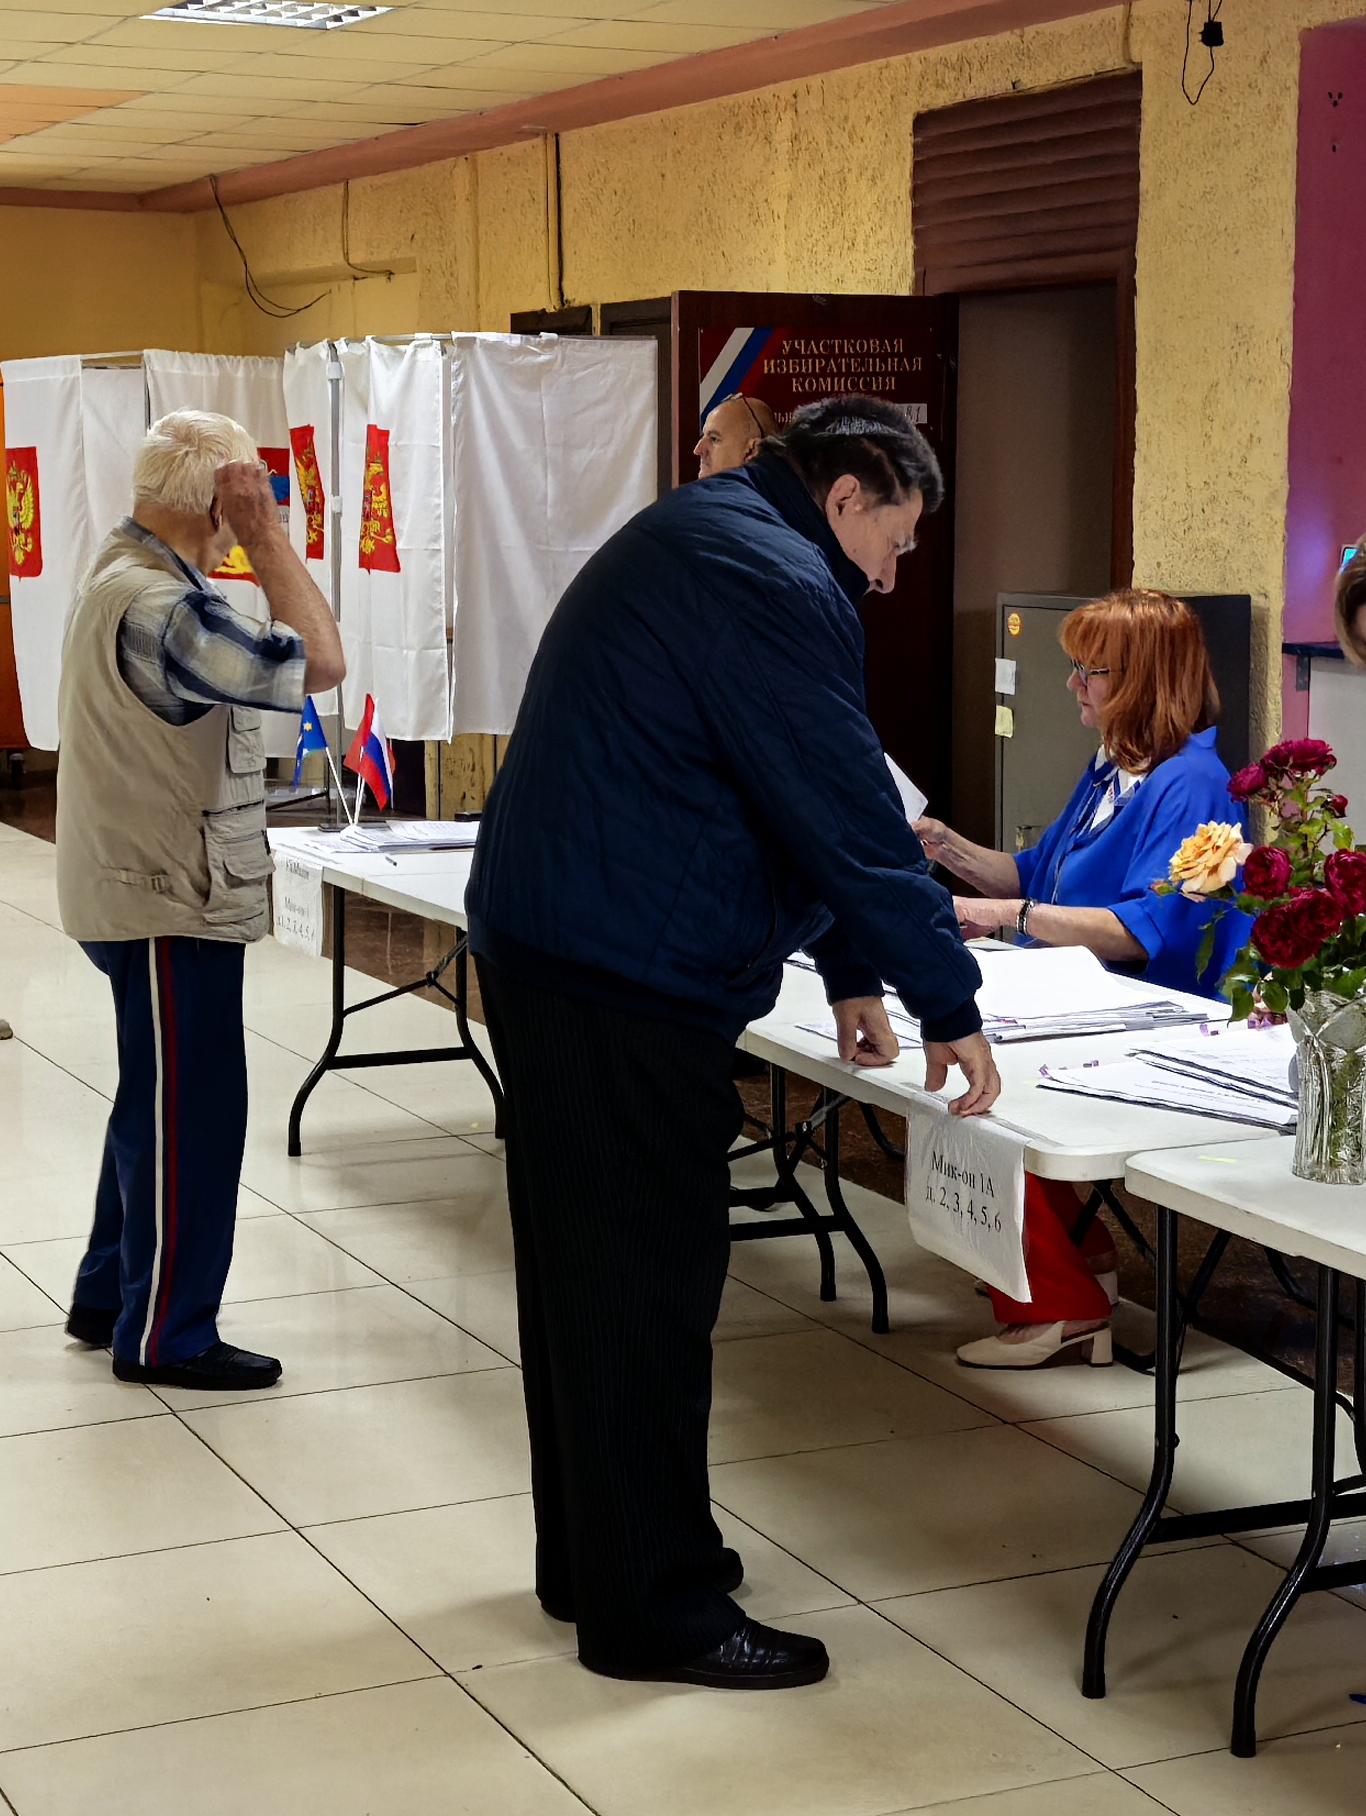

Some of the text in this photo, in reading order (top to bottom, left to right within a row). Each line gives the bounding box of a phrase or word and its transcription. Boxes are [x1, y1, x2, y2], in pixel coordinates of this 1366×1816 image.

[782, 338, 904, 355] УЧАСТКОВАЯ
[763, 356, 923, 374] ИЗБИРАТЕЛЬНАЯ
[792, 376, 896, 392] КОМИССИЯ
[931, 1151, 976, 1189] Мик-он
[926, 1185, 936, 1203] д.
[994, 1212, 1003, 1233] 6
